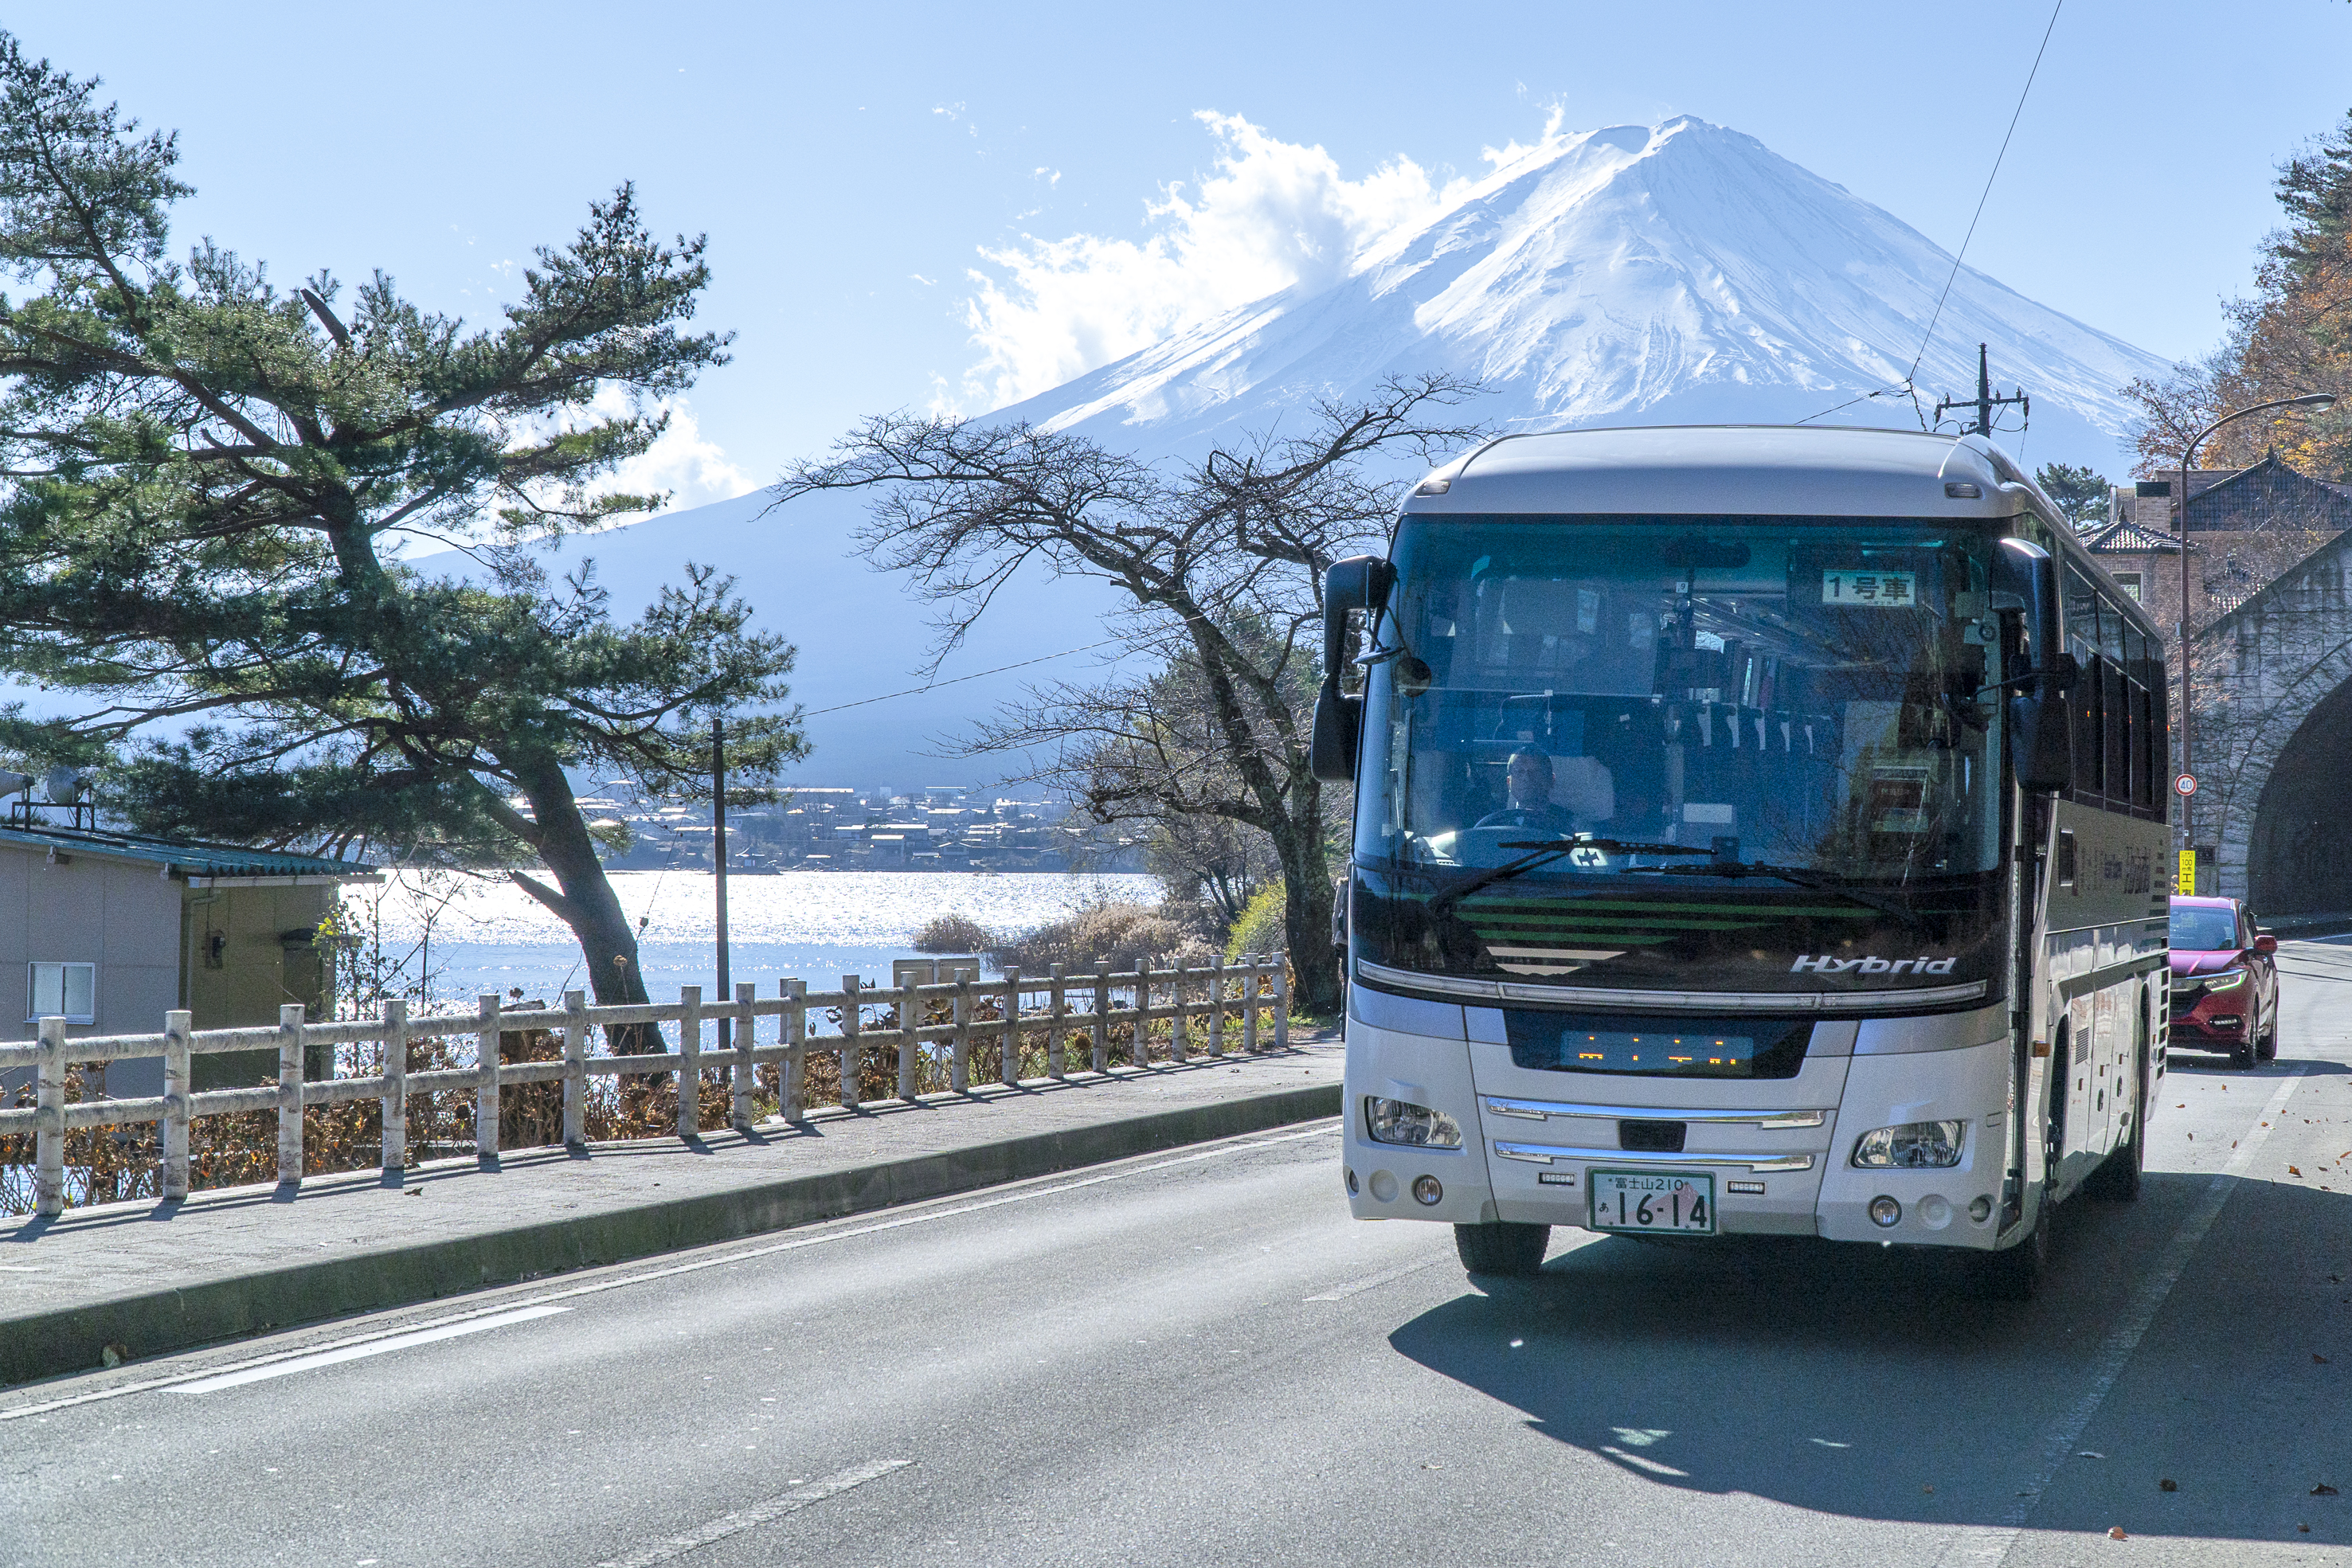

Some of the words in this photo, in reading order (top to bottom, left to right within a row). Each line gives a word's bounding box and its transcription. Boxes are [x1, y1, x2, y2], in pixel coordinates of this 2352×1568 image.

[1829, 576, 1910, 600] 1号車
[2180, 780, 2192, 789] 40
[1790, 955, 1957, 974] Hybrid
[1599, 1202, 1609, 1213] あ
[1619, 1191, 1708, 1228] 16-14
